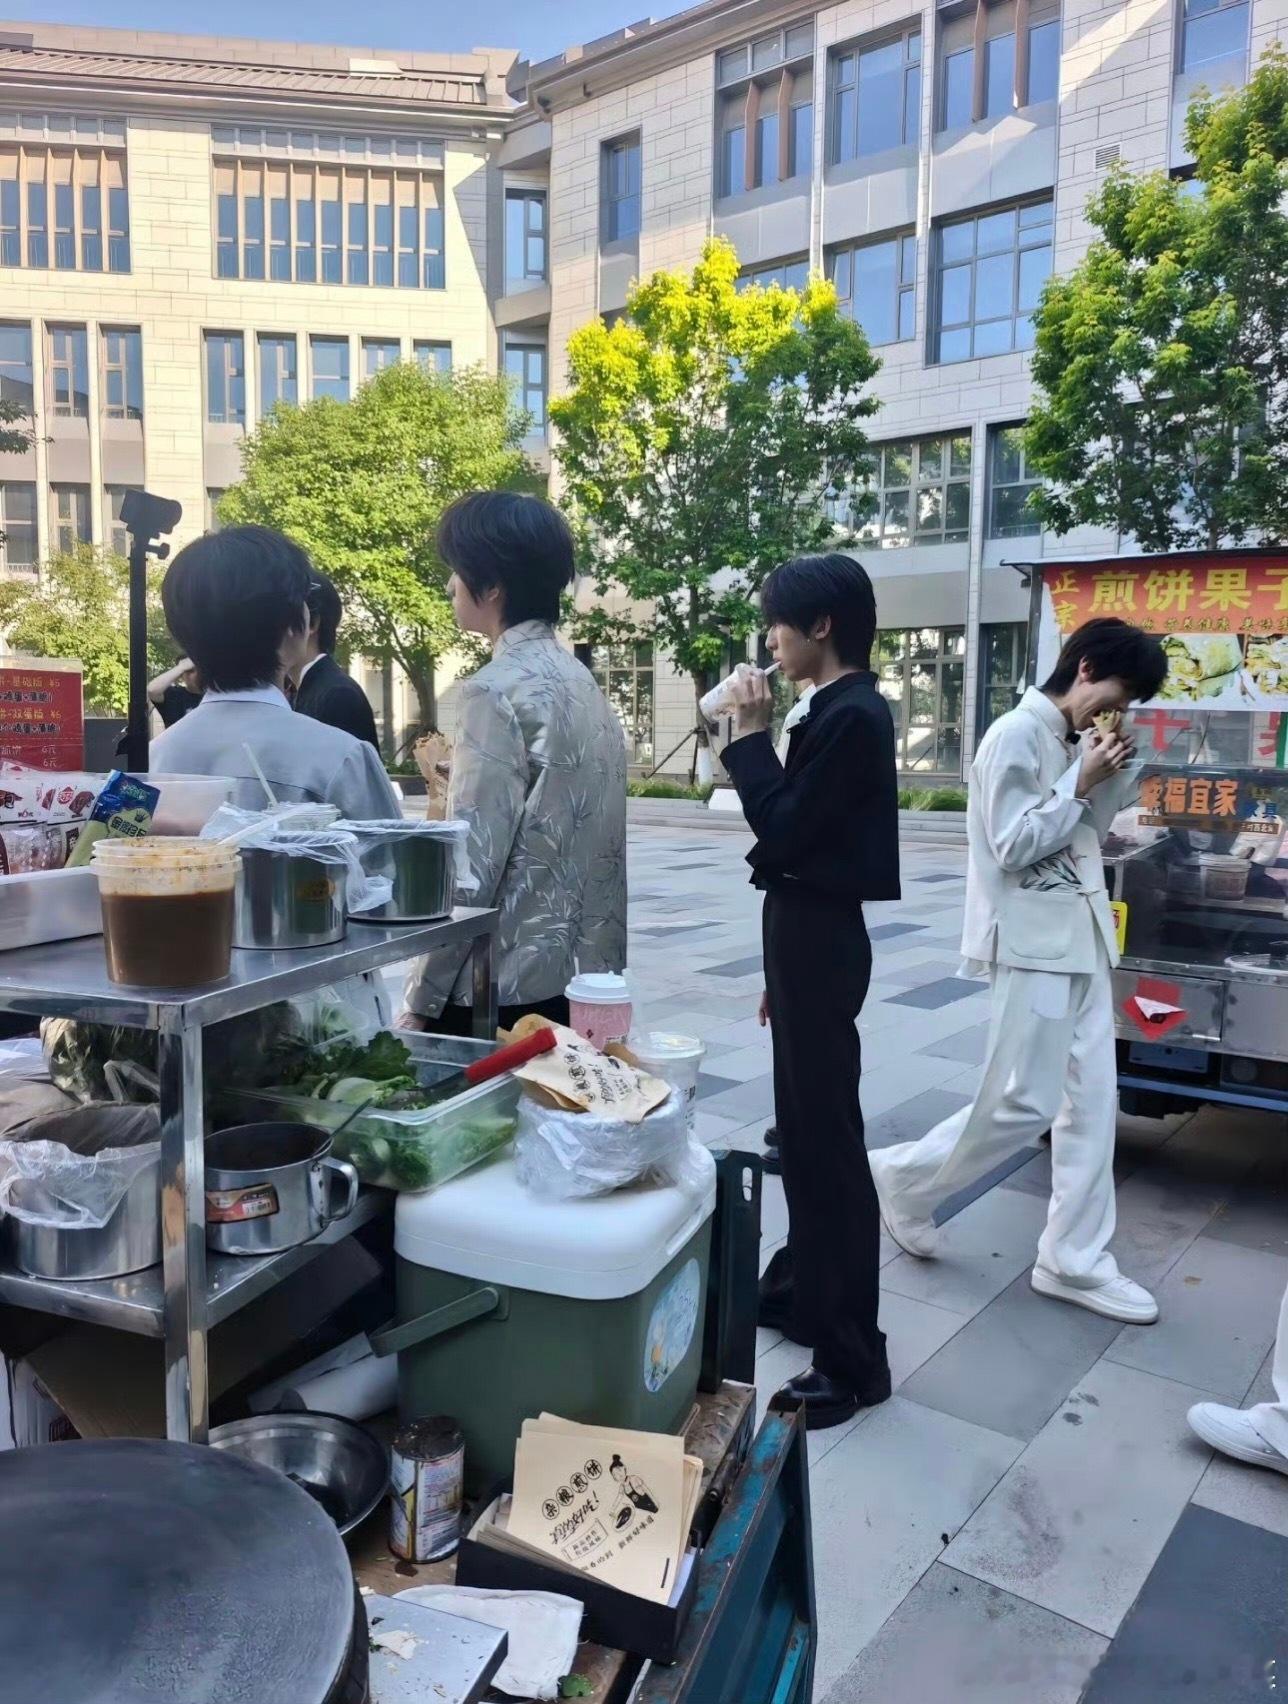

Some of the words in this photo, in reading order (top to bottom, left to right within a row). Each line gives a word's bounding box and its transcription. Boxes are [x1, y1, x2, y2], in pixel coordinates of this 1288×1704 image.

[1088, 567, 1288, 613] 煎饼果子
[542, 1458, 602, 1520] 杂粮煎饼
